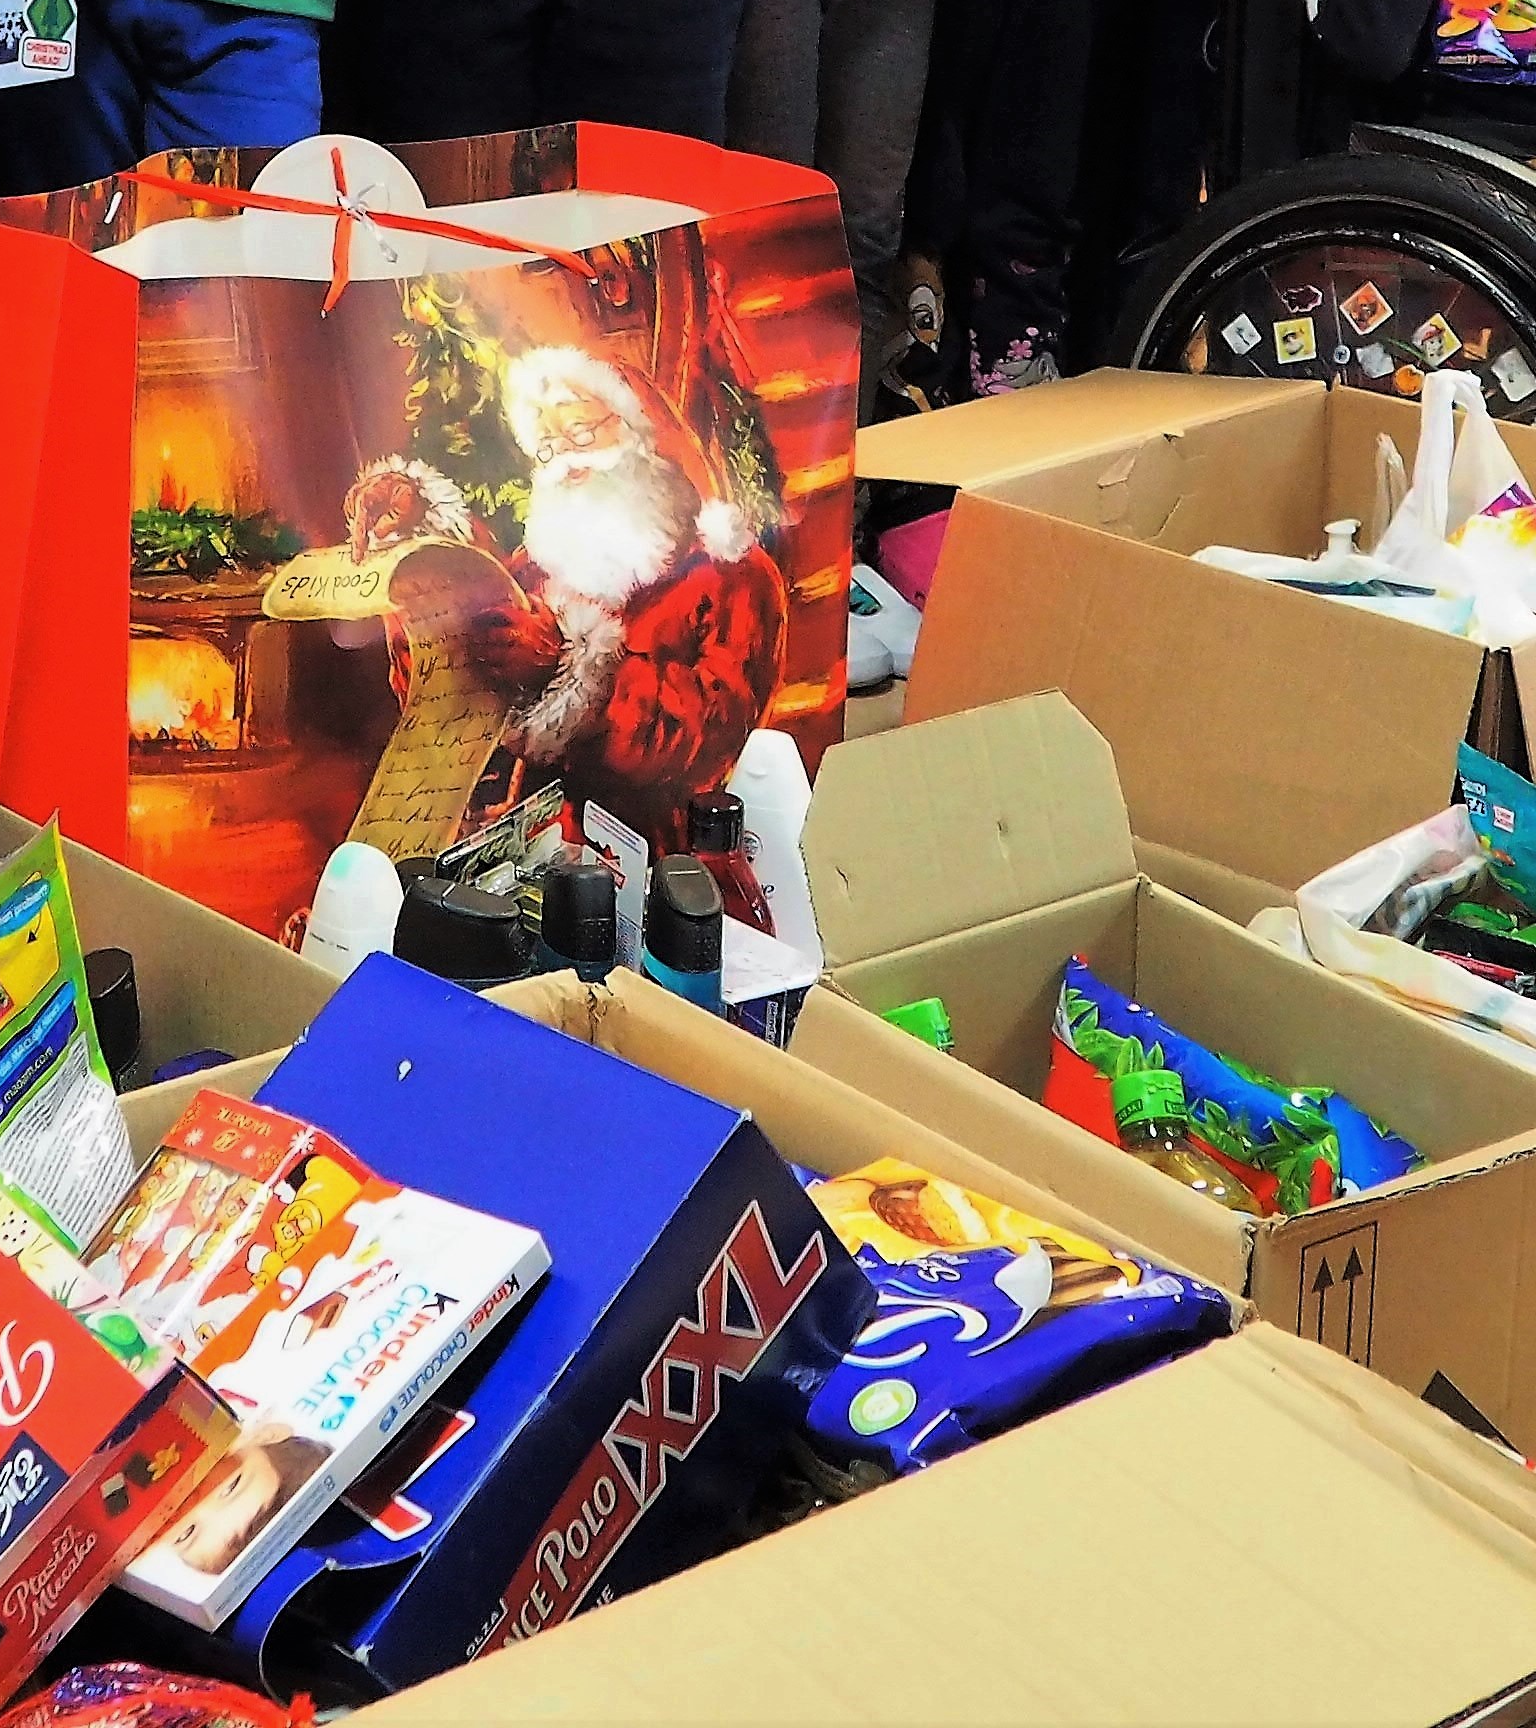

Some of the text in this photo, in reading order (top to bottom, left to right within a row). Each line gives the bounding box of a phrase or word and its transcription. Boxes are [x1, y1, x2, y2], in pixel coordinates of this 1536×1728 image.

[26, 42, 68, 56] CHRISTMAS
[292, 1282, 429, 1416] CHOCOLATE
[354, 1292, 461, 1393] Kinder
[399, 1272, 522, 1410] Kinder CHOCOLATE
[603, 1199, 828, 1509] XXL
[535, 1476, 617, 1591] POLO
